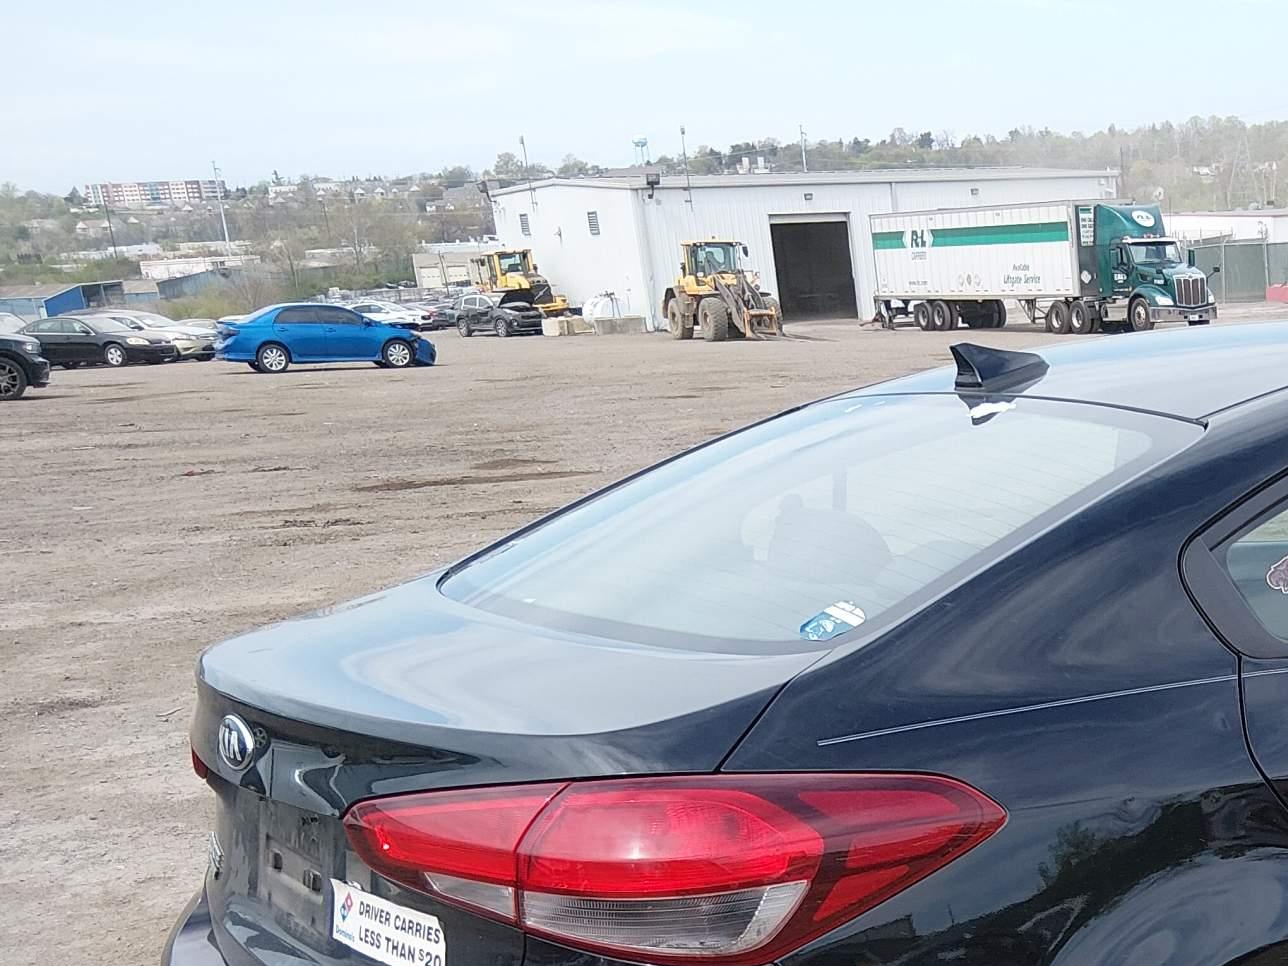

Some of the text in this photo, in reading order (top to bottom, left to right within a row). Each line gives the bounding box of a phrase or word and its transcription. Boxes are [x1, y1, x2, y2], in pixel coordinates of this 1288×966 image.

[1024, 273, 1041, 284] Service
[358, 900, 441, 945] DRIVER CARRIES
[358, 925, 382, 950] LESS
[384, 936, 416, 964] THAN
